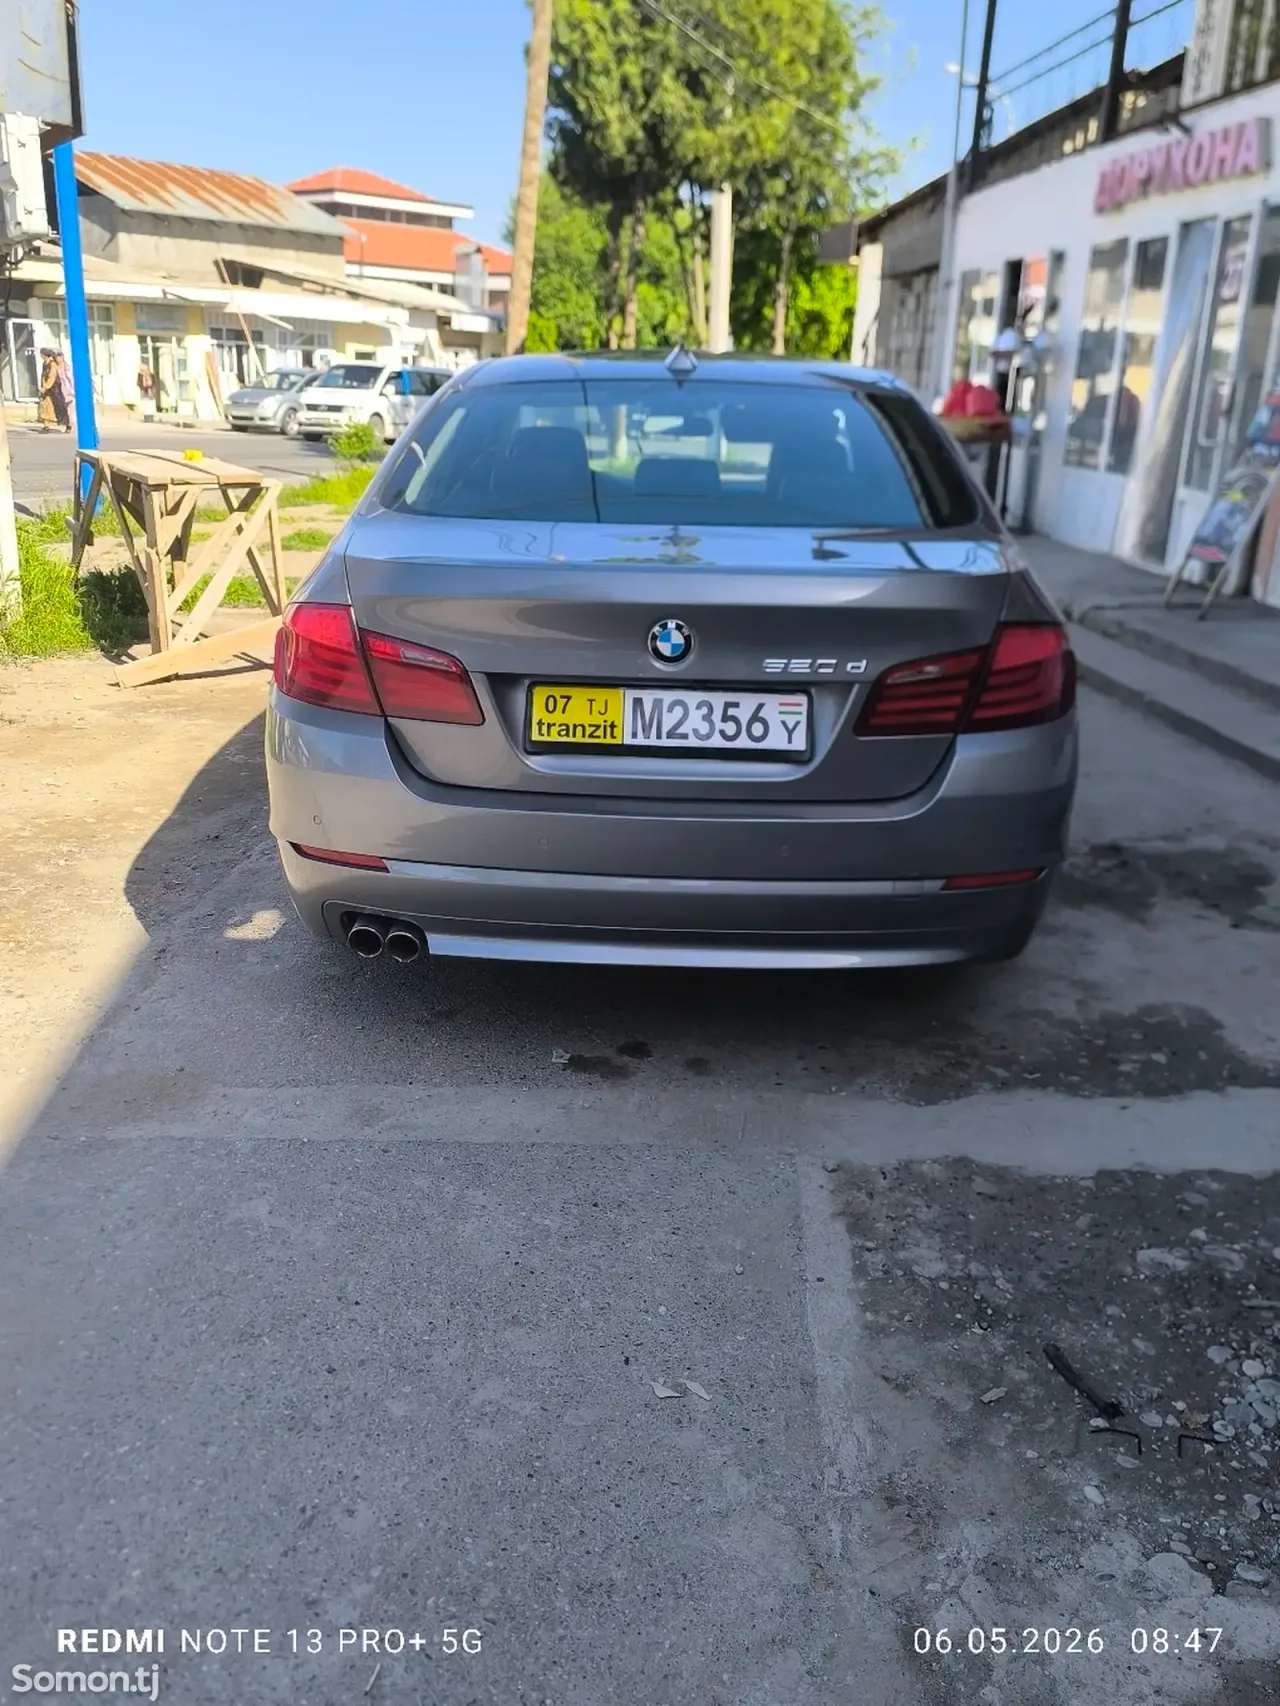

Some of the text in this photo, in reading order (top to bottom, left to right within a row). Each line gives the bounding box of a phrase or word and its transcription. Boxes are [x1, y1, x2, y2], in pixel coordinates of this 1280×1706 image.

[846, 659, 868, 673] d
[544, 694, 608, 716] 07 TJ
[536, 718, 618, 740] tranzit
[631, 697, 802, 745] M2356 Y
